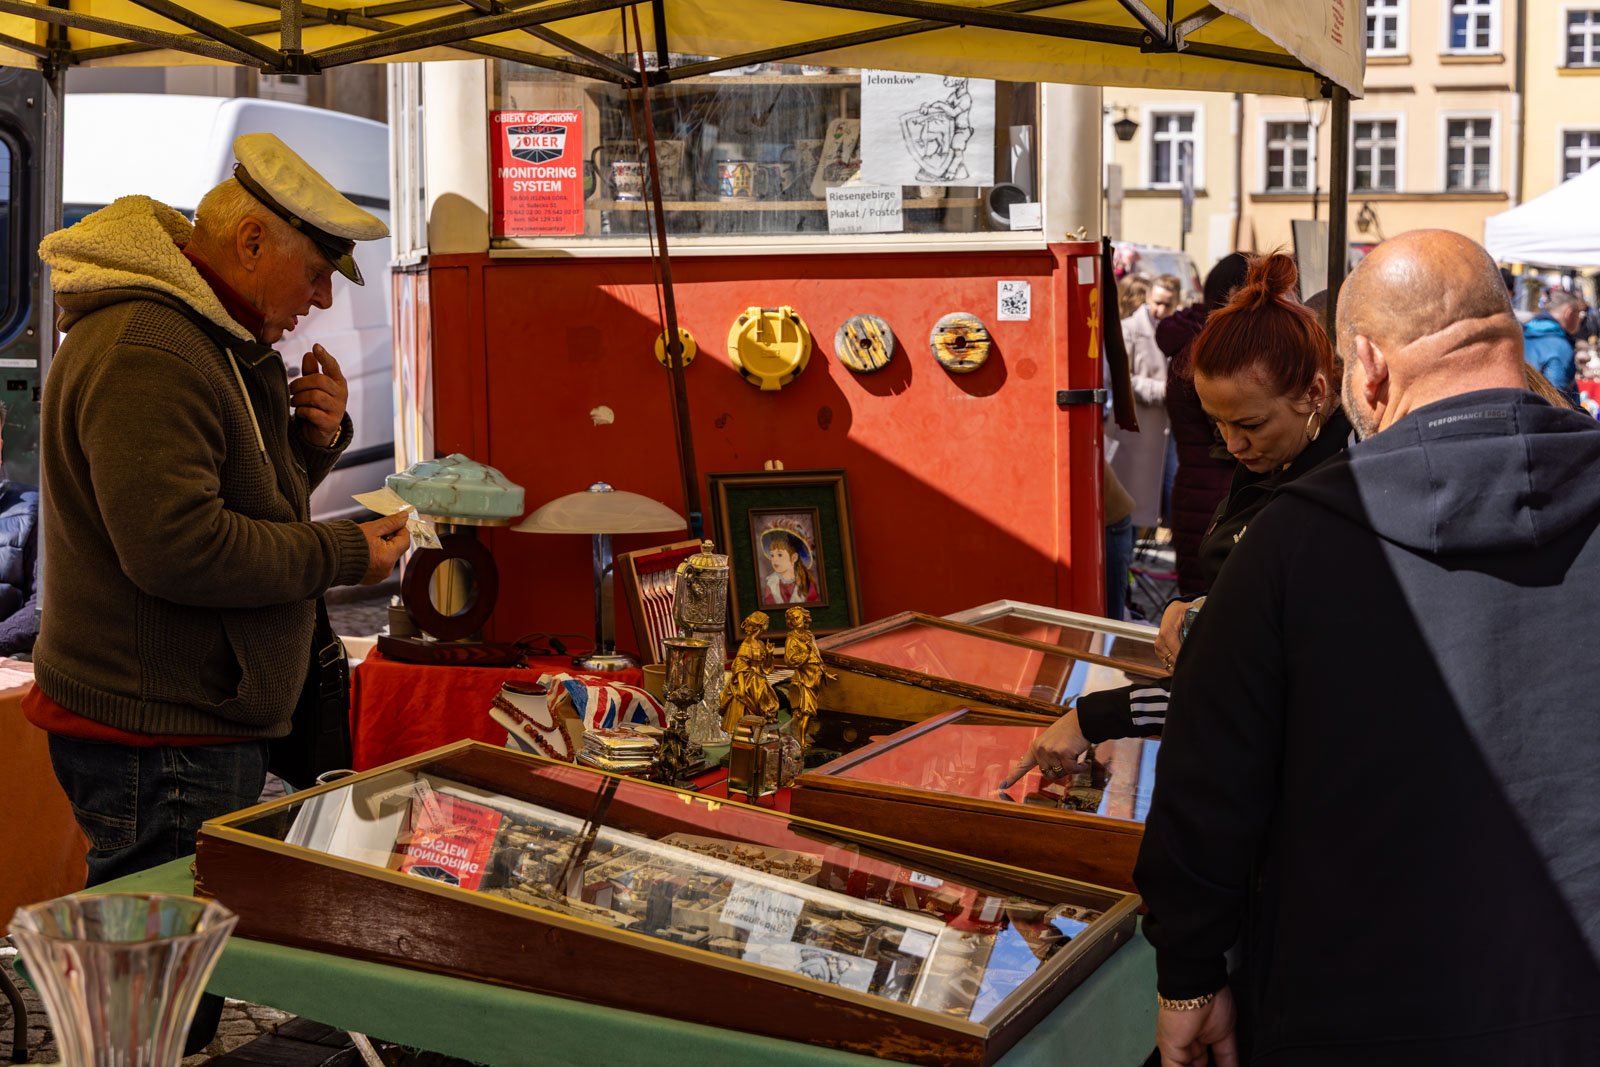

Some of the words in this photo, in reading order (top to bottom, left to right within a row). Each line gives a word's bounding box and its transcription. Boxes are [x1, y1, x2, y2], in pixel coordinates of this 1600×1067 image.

[495, 113, 525, 123] OBIEKT
[527, 113, 578, 123] CHRONIONY
[516, 136, 559, 149] JOKER
[498, 166, 577, 179] MONITORING
[513, 180, 562, 192] SYSTEM
[829, 190, 896, 202] Riesengebirge
[830, 209, 860, 219] Plakat
[861, 208, 867, 219] /
[869, 207, 899, 217] Poster
[1003, 283, 1014, 292] A2
[1428, 411, 1483, 428] PERFORMANCE
